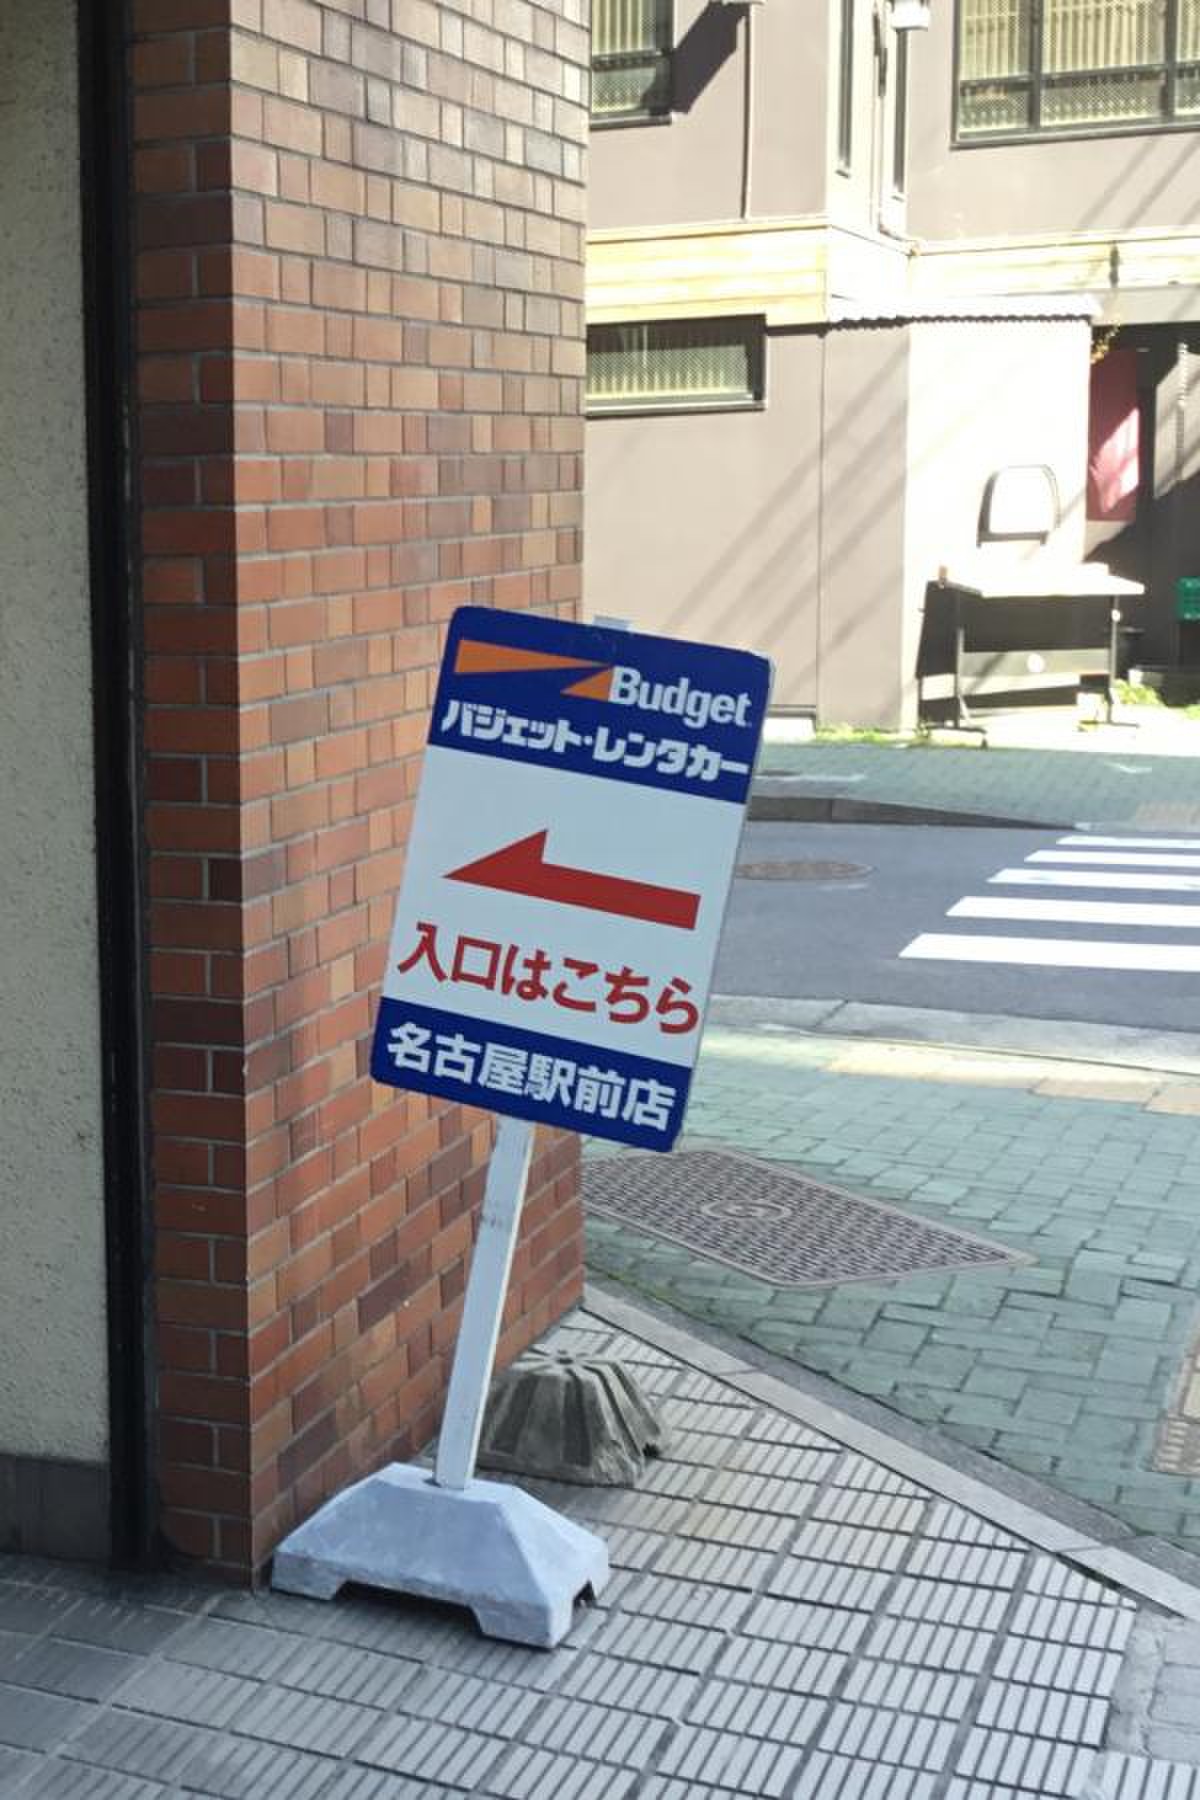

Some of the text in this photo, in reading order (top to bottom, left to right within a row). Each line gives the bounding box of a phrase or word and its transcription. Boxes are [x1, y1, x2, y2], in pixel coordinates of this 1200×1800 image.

[441, 699, 750, 782] バジェット・レンタカー
[608, 665, 753, 729] Budget
[397, 921, 699, 1035] 入口はこちら
[386, 1022, 677, 1132] 名古屋駅前店
